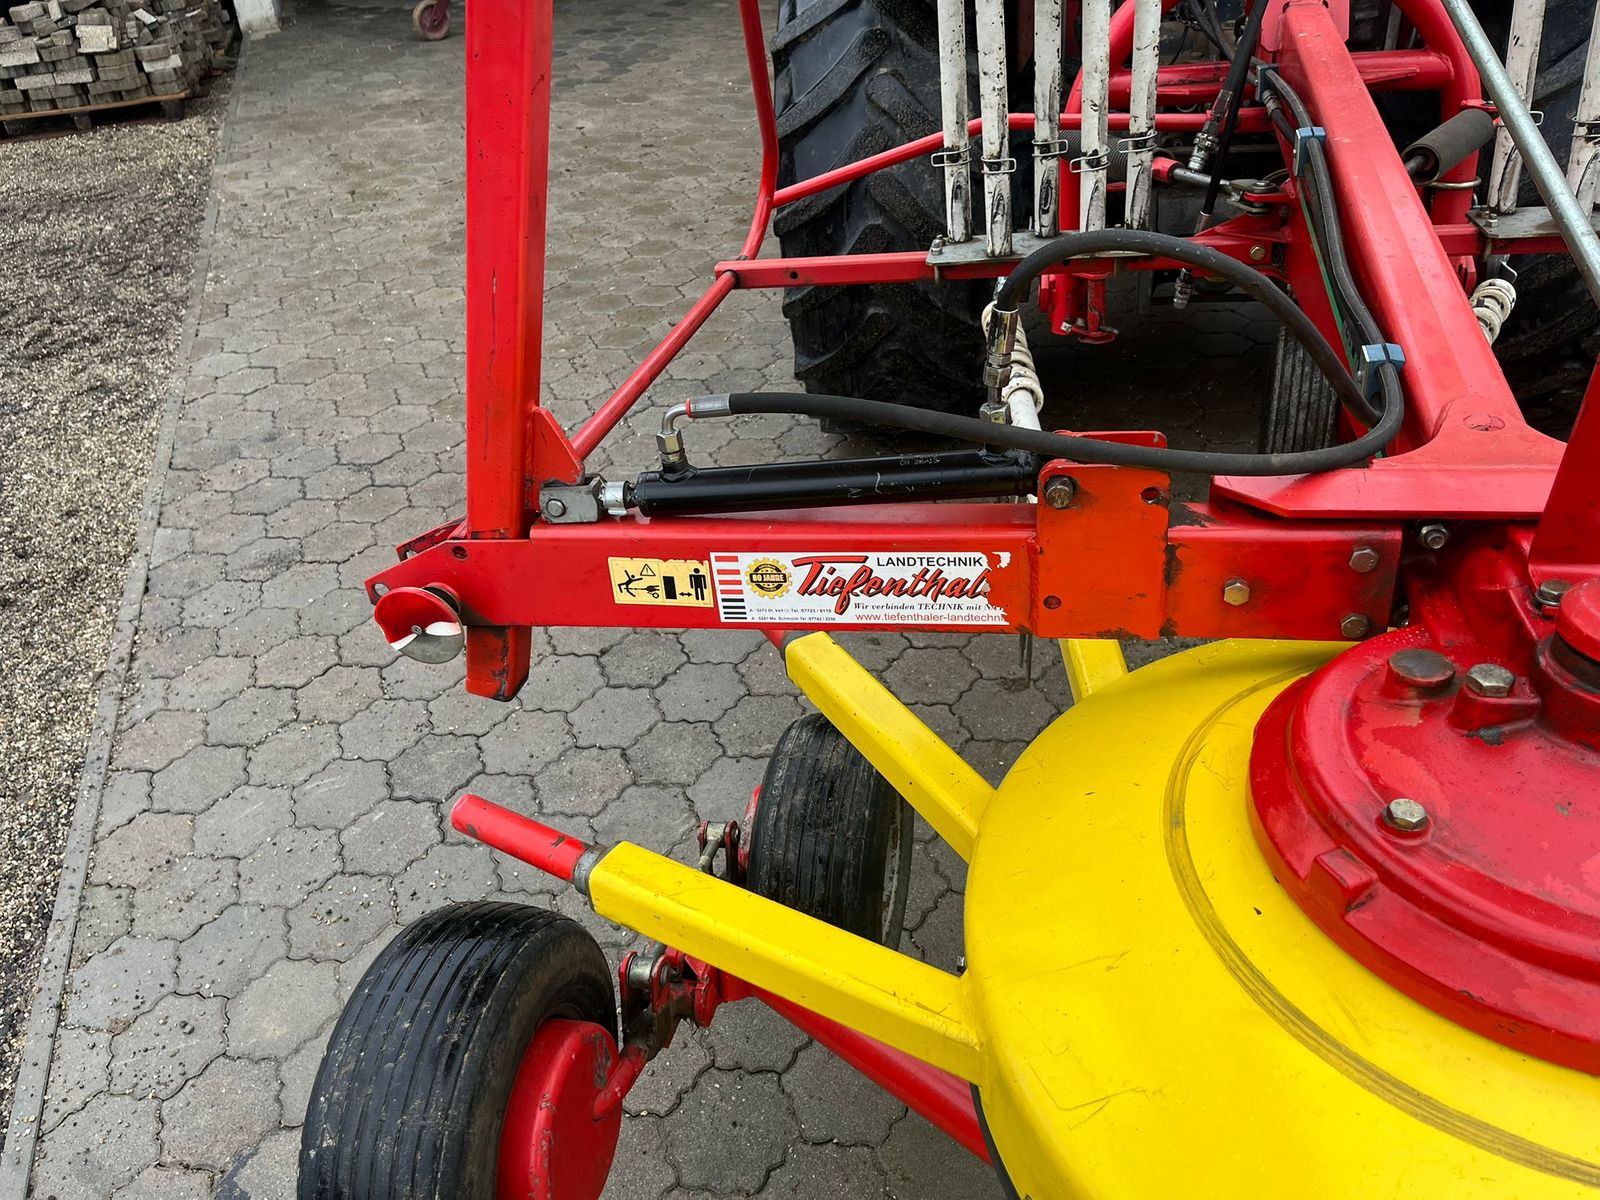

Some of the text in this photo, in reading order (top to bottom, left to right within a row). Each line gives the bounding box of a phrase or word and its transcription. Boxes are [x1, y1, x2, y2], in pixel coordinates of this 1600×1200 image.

[876, 556, 984, 568] LANDTECHNIK
[763, 574, 785, 582] JAHRE
[791, 555, 990, 615] Tiefenthal
[854, 602, 869, 610] Wir
[872, 602, 915, 610] verbinden
[918, 602, 964, 611] TECHNIK
[966, 603, 981, 611] mit
